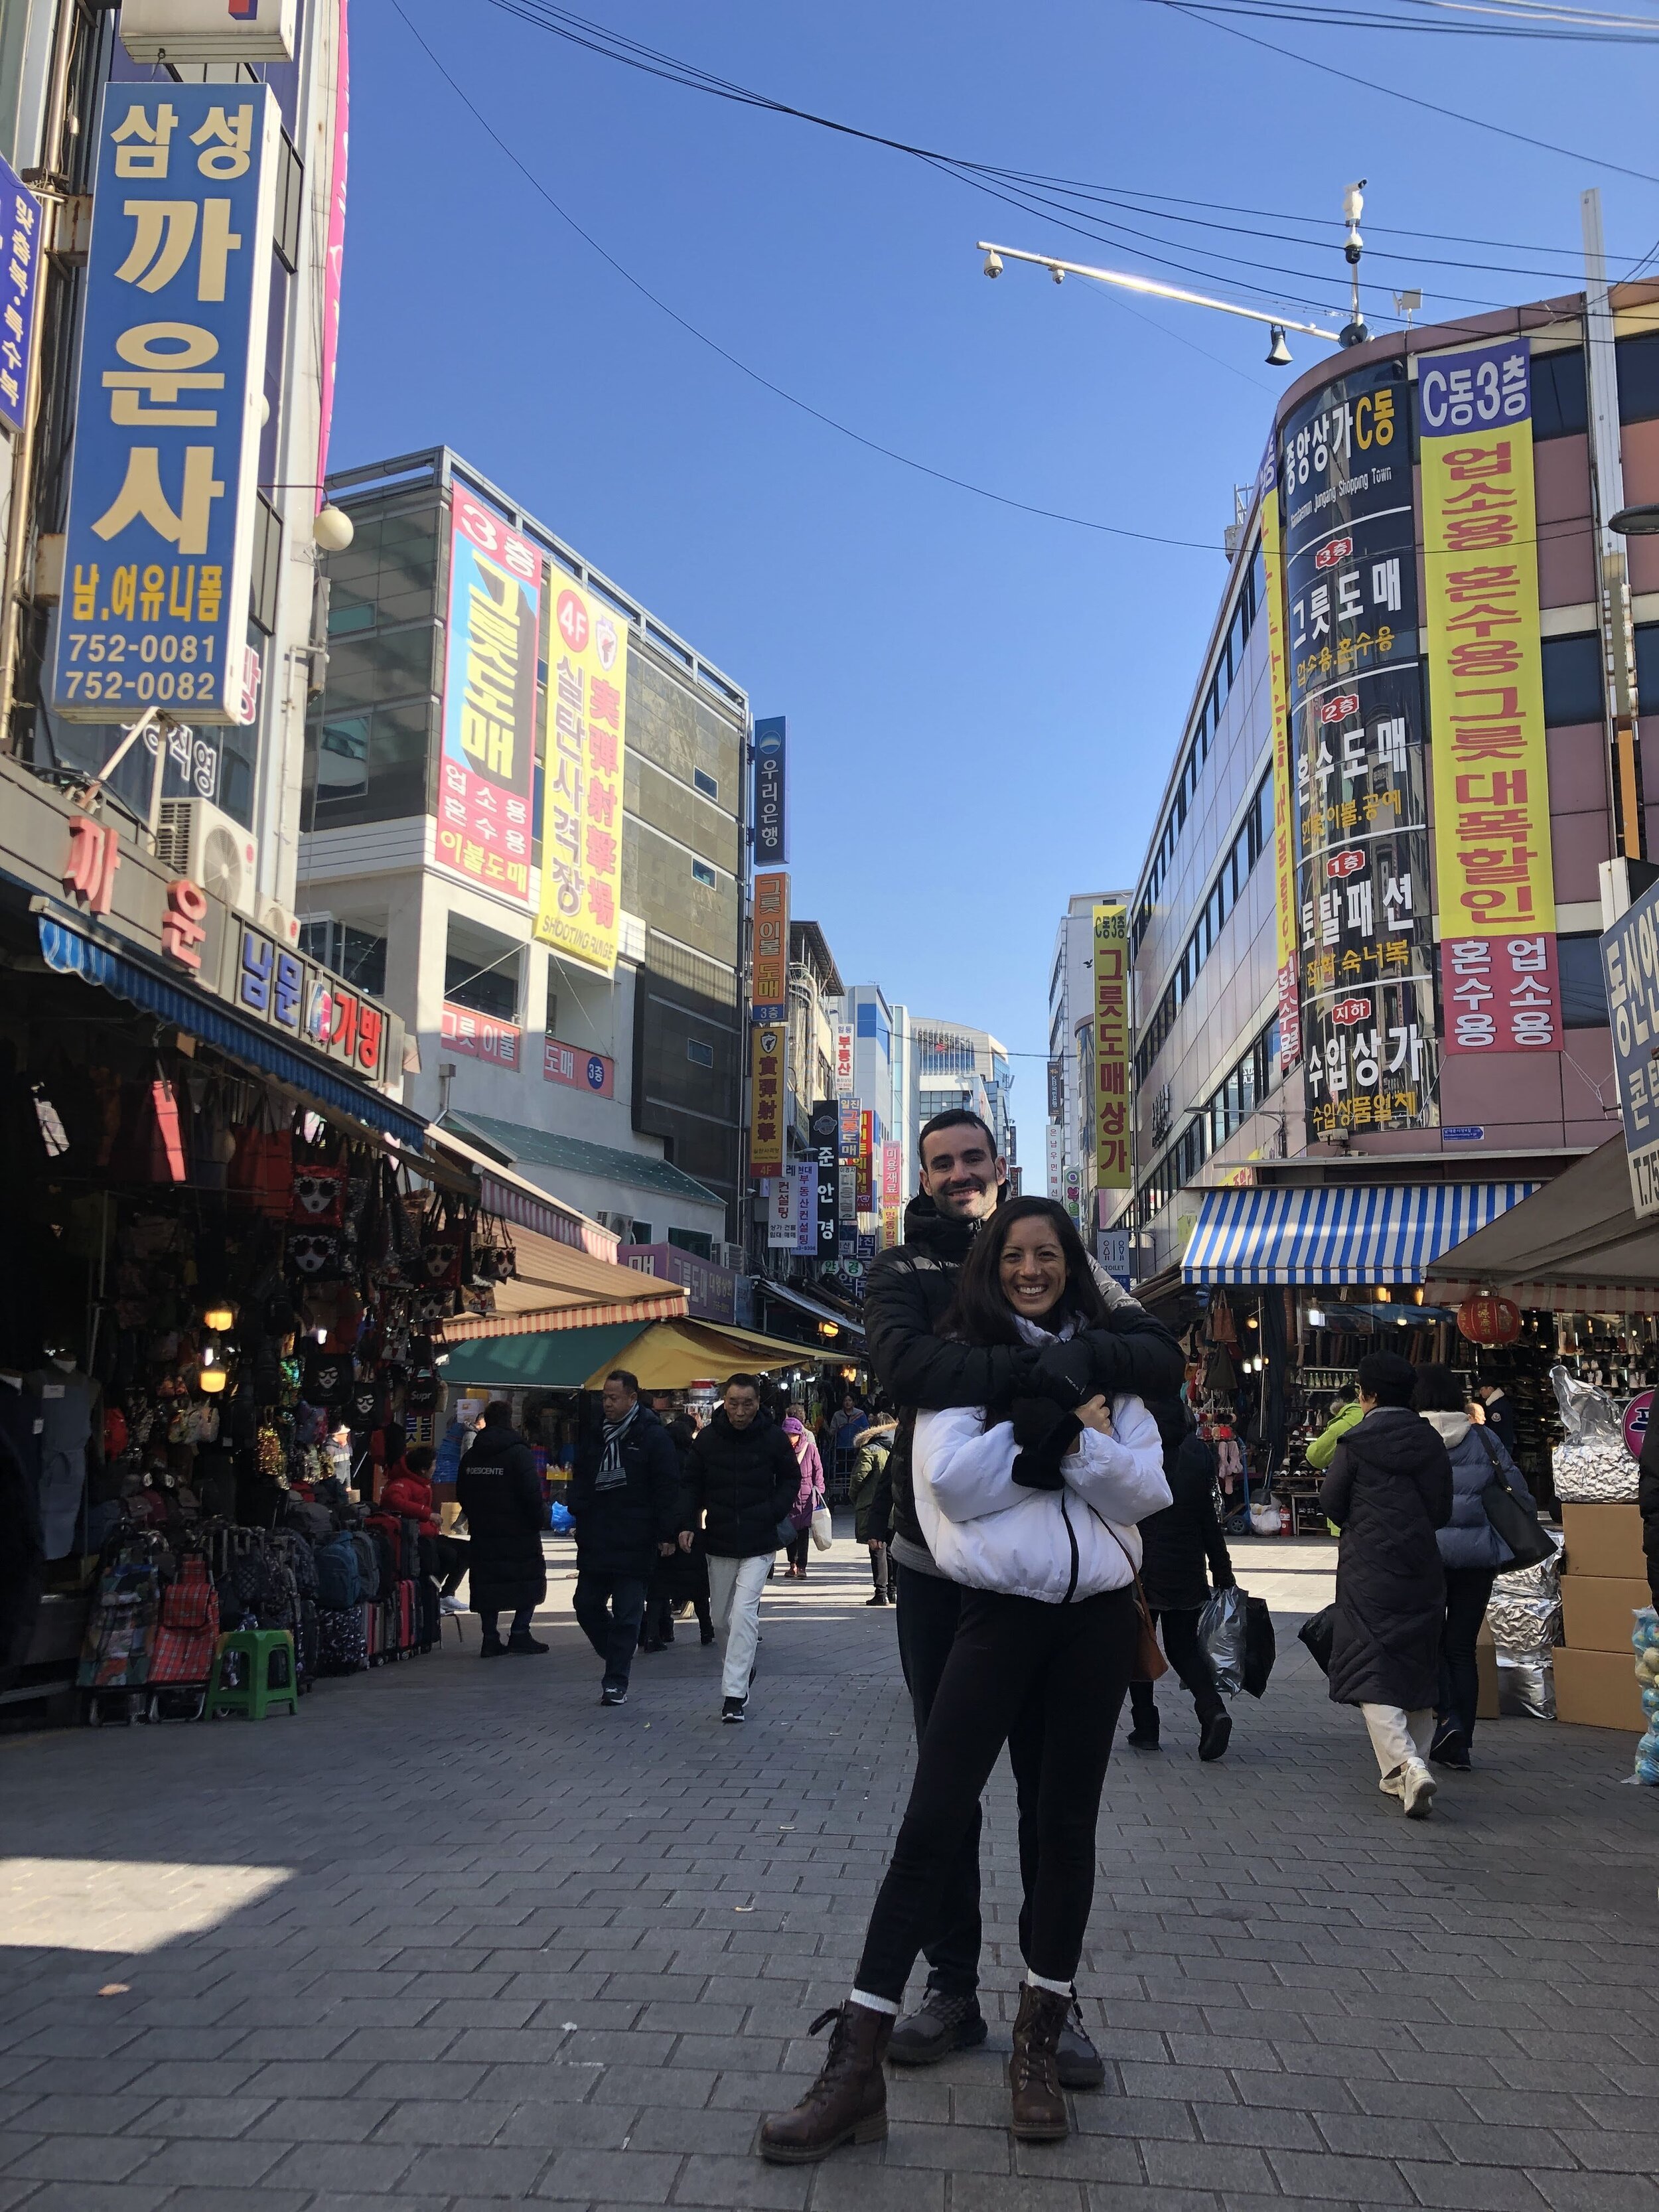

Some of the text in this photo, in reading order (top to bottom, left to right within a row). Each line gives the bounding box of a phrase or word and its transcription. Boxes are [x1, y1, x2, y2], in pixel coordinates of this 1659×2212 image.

[110, 104, 253, 180] 삼성
[1423, 354, 1528, 427] C동3층
[1338, 473, 1368, 496] Shopping
[1372, 466, 1392, 484] Town
[1442, 441, 1519, 551] 업소용
[461, 503, 536, 577] 3층
[1319, 541, 1348, 564] 3층
[559, 599, 587, 642] 4F
[1293, 557, 1402, 650] 그릇도매
[1445, 565, 1524, 676] 혼수용
[69, 634, 215, 663] 752-0081
[66, 672, 214, 701] 752-0082
[1325, 698, 1354, 720] 2층
[552, 656, 587, 917] 실탄사격장
[1297, 717, 1407, 807] 혼수도매
[760, 759, 779, 847] 우리은행
[440, 830, 528, 895] 이불도매
[1331, 854, 1359, 873] 1층
[1455, 769, 1538, 925] 대폭할인
[758, 879, 781, 999] 그릇 이불 도매
[1095, 915, 1125, 939] C동3층
[1301, 871, 1414, 952] 토탈패션
[242, 932, 382, 1068] 남문 가방
[1335, 1002, 1366, 1020] 지하
[1451, 940, 1496, 1047] 혼수용
[1507, 936, 1554, 1046] 업소용
[1607, 899, 1659, 1058] 동신안
[441, 1009, 516, 1062] 그릇 이불
[760, 1006, 779, 1020] 3층
[544, 1043, 604, 1083] 도매 3층
[837, 1035, 851, 1076] 부동산
[1098, 948, 1127, 1173] 그릇도매상가
[1309, 1023, 1423, 1099] 수입상가
[840, 1110, 860, 1157] 그릇도매
[1313, 1091, 1417, 1132] 수입상품일체
[760, 1165, 772, 1175] 4F
[778, 1181, 790, 1219] 컨설팅
[886, 1148, 899, 1194] 미용재료
